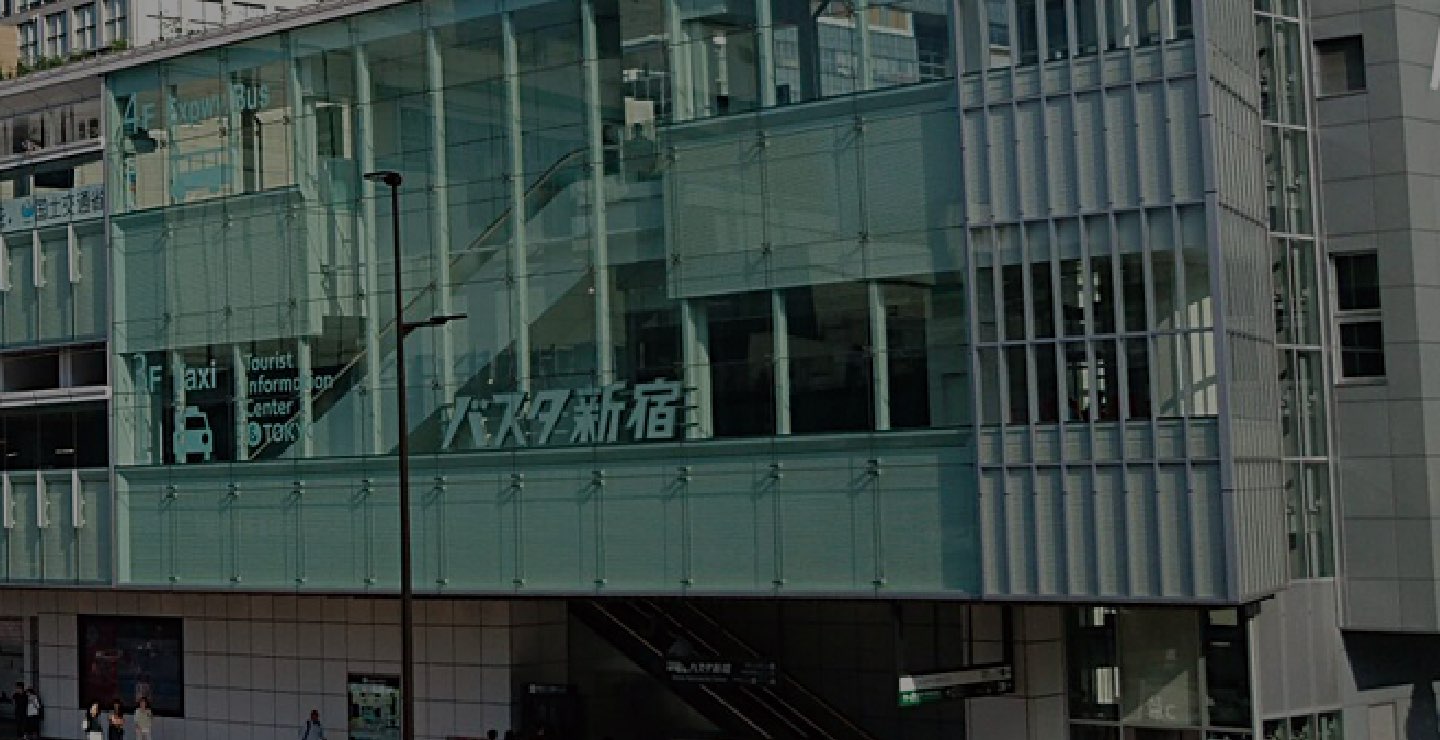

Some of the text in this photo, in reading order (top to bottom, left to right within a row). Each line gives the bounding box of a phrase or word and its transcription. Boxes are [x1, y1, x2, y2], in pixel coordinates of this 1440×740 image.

[243, 351, 294, 371] Tourist
[441, 378, 681, 449] バスタ新宿
